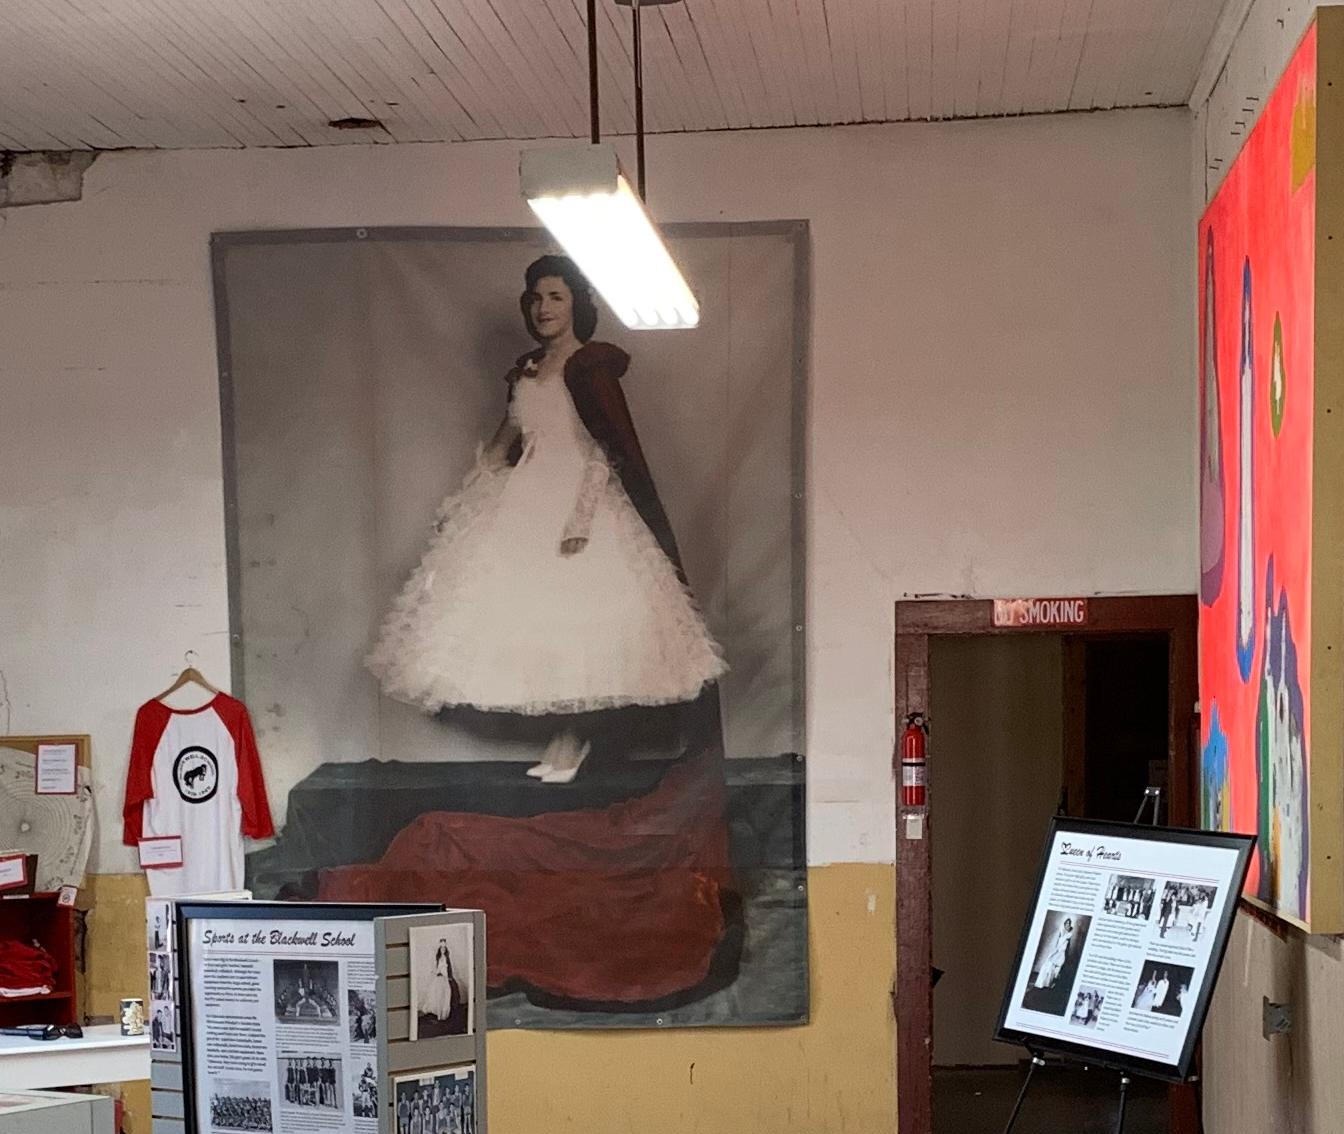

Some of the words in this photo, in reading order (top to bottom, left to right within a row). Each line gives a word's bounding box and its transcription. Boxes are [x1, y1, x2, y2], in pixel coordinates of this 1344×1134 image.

[1018, 599, 1084, 624] SMOKING
[1060, 842, 1084, 857] Queen
[1086, 845, 1095, 862] of
[202, 930, 235, 946] Sports
[238, 933, 249, 944] at
[251, 930, 267, 945] the
[269, 930, 318, 946] Blackwell
[320, 932, 356, 947] School
